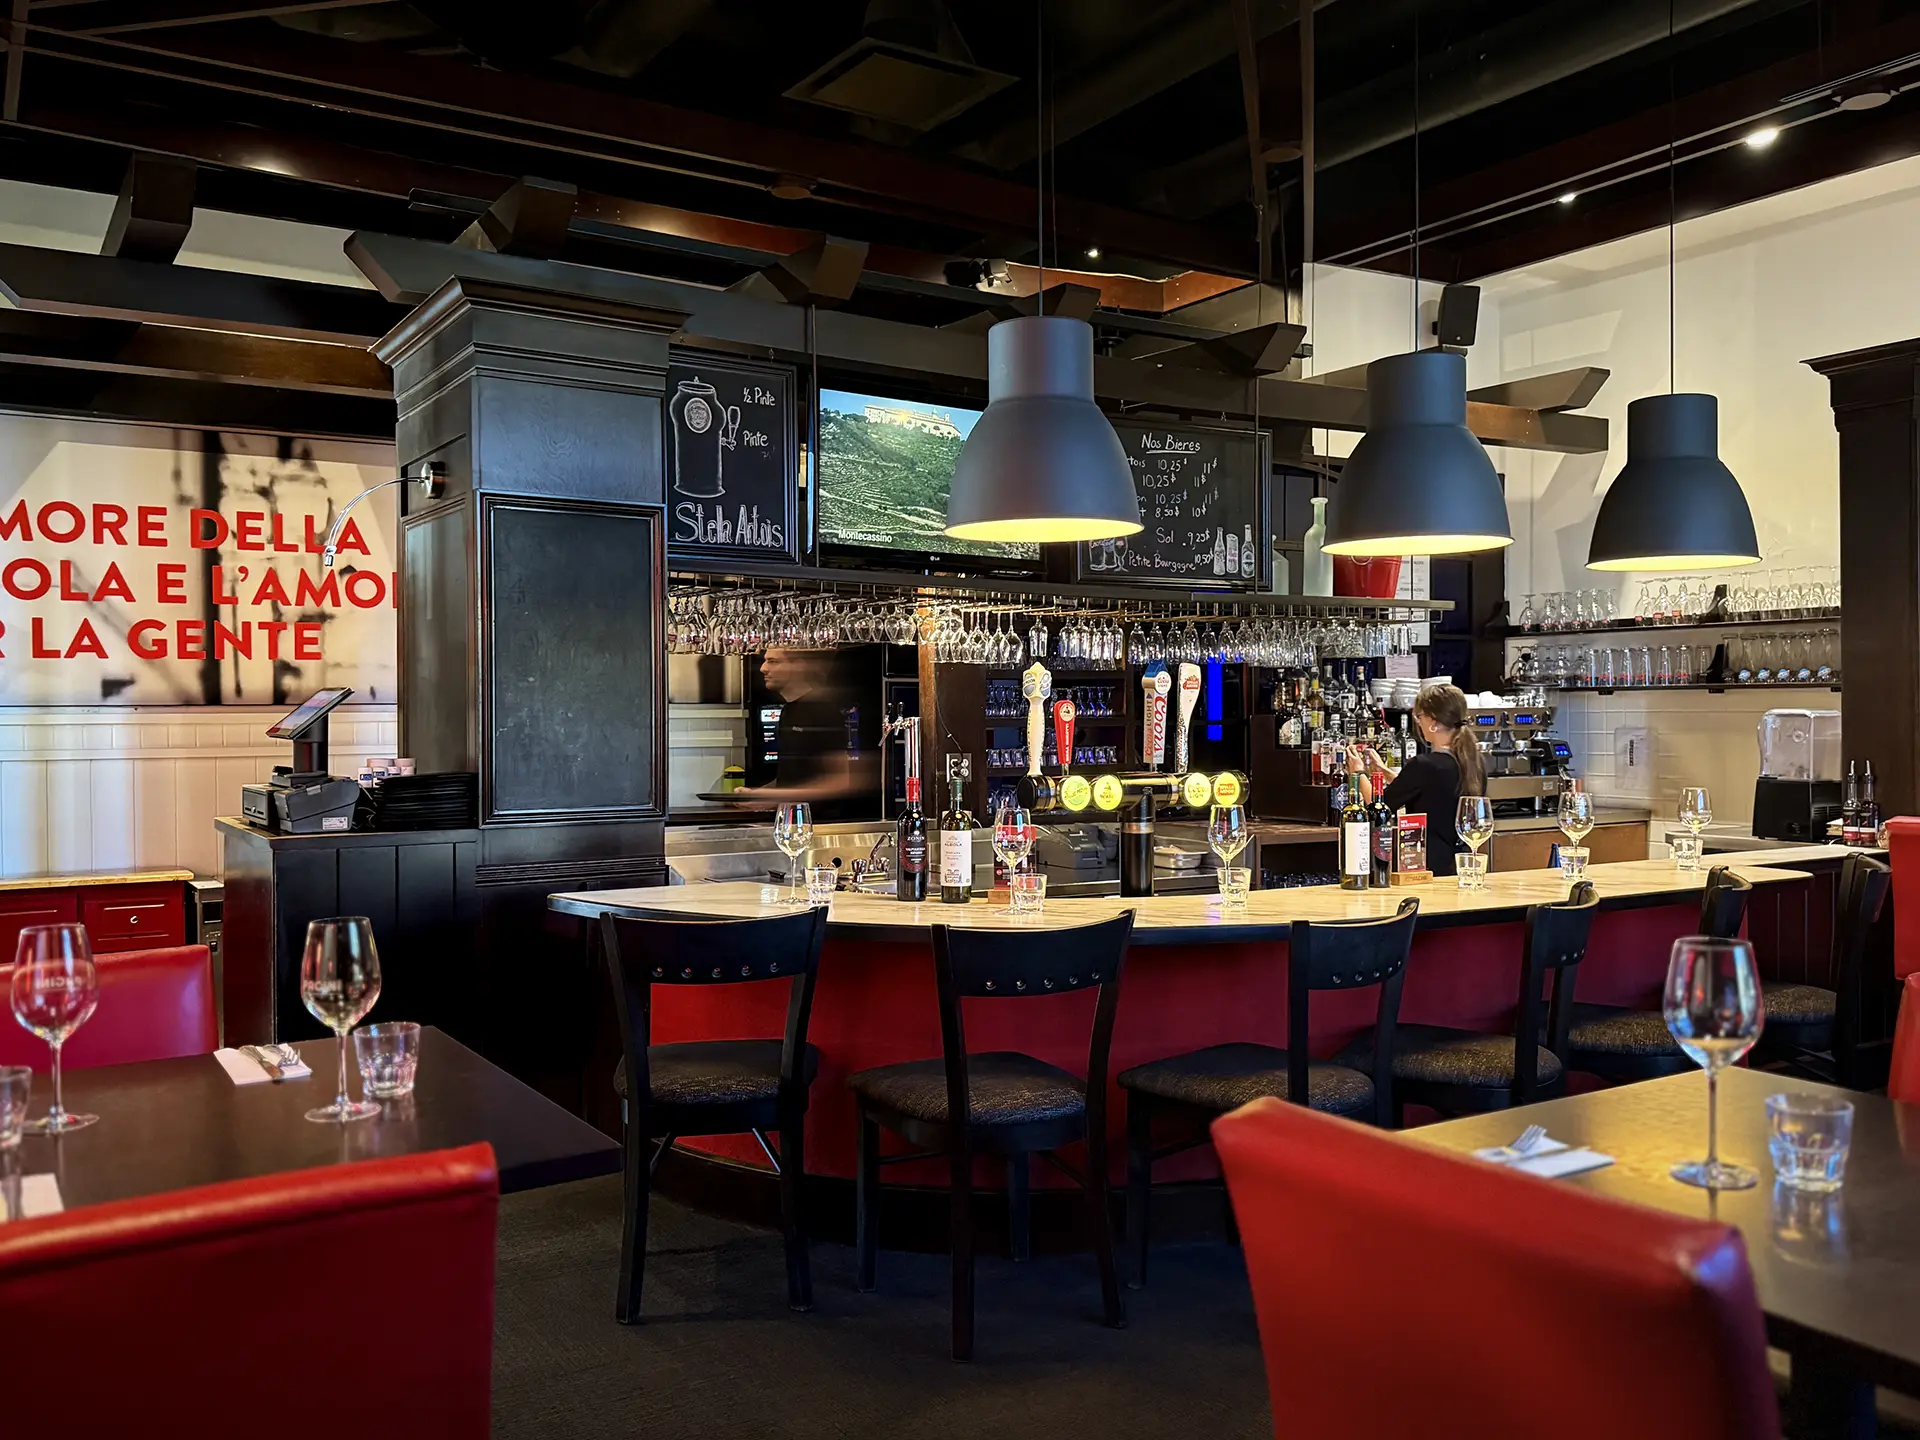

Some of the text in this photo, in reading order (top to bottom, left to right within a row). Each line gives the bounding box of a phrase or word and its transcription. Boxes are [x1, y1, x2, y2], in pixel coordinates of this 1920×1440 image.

[754, 386, 776, 406] Pinte
[742, 430, 769, 447] Pinte
[1141, 432, 1201, 452] Nos Bieres
[190, 508, 372, 556] DELLA
[675, 502, 784, 548] Stella Artois
[839, 528, 893, 543] Montecassino
[1155, 527, 1174, 544] Sol
[1128, 550, 1151, 569] Petite
[1154, 553, 1196, 573] Bourgogne
[2, 557, 397, 609] OLA E L'AMO
[32, 617, 109, 659] LA
[127, 618, 322, 661] GENTE
[1154, 696, 1167, 753] Coors
